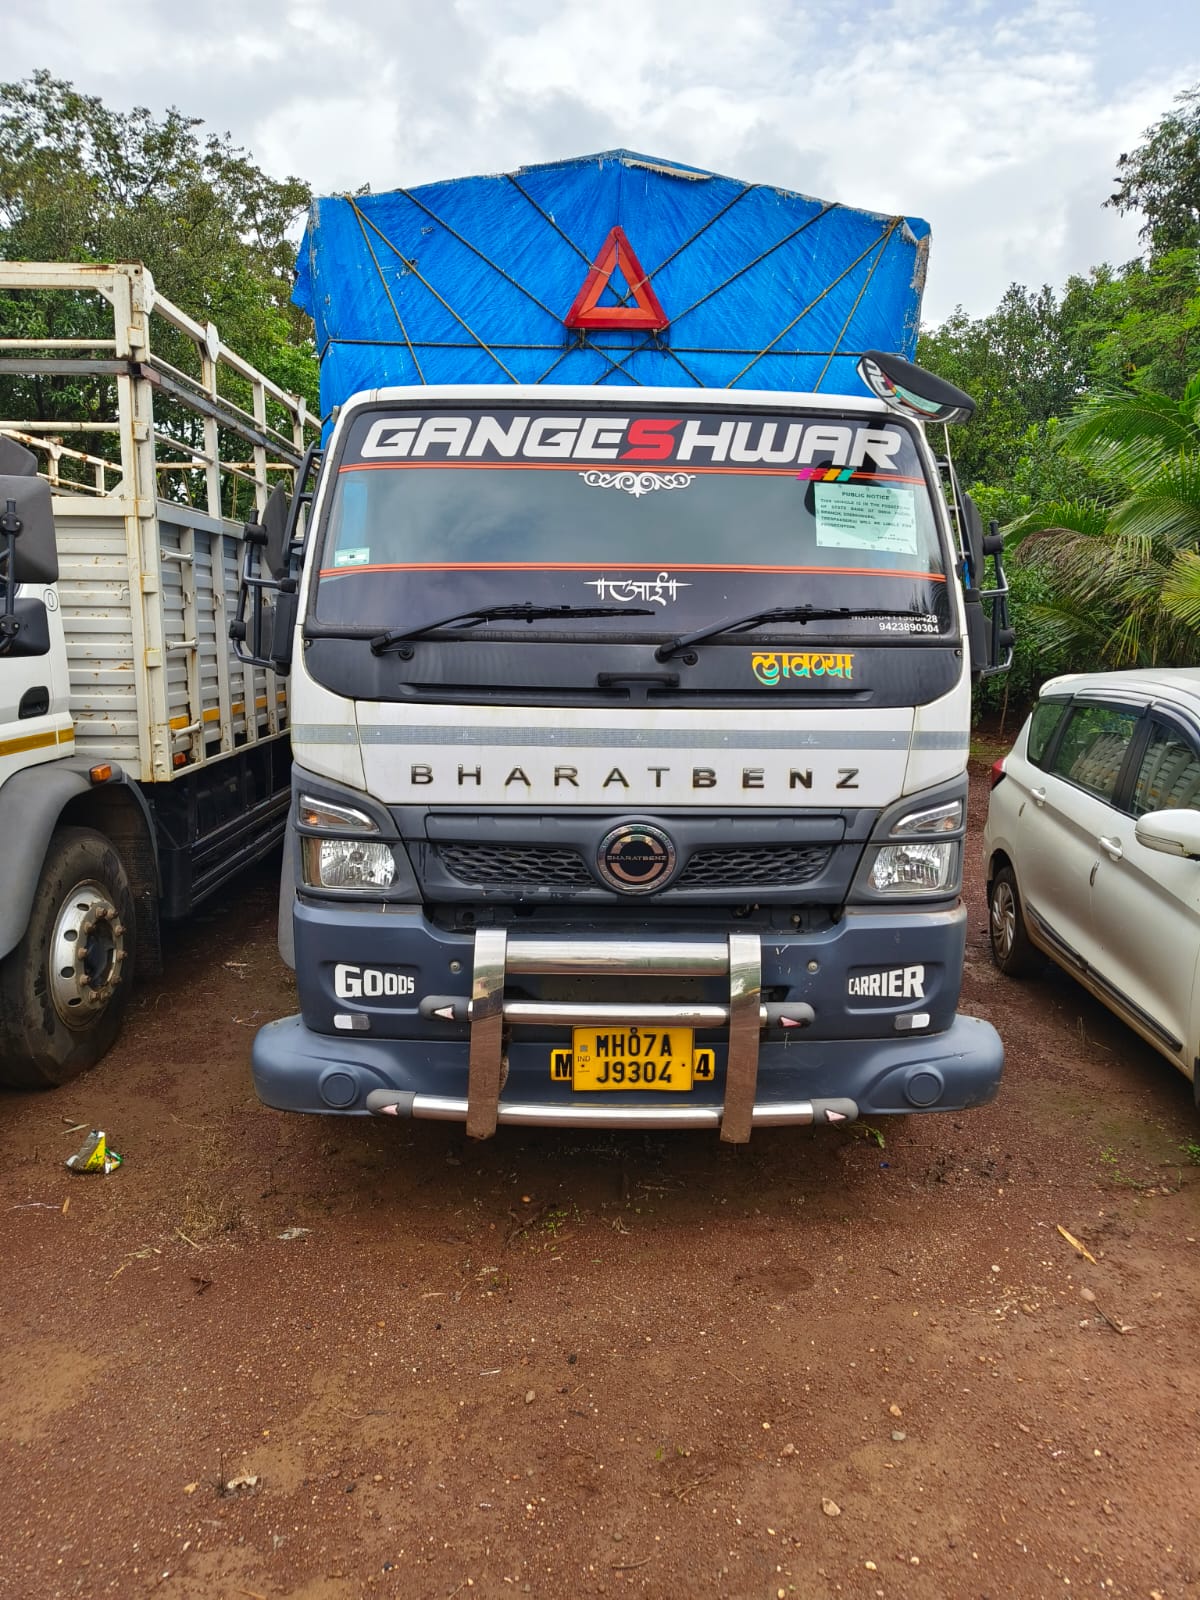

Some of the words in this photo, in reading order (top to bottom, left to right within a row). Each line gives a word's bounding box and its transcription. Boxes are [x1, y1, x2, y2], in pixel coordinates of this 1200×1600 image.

[361, 417, 902, 469] GANGESHWAR
[879, 622, 939, 633] 9423890304
[752, 652, 855, 686] लावण्या
[410, 763, 860, 789] BHARATBENZ
[335, 964, 415, 998] GOODS
[848, 965, 925, 998] CARRIER
[596, 1033, 673, 1058] MH07A
[596, 1060, 672, 1084] J9304
